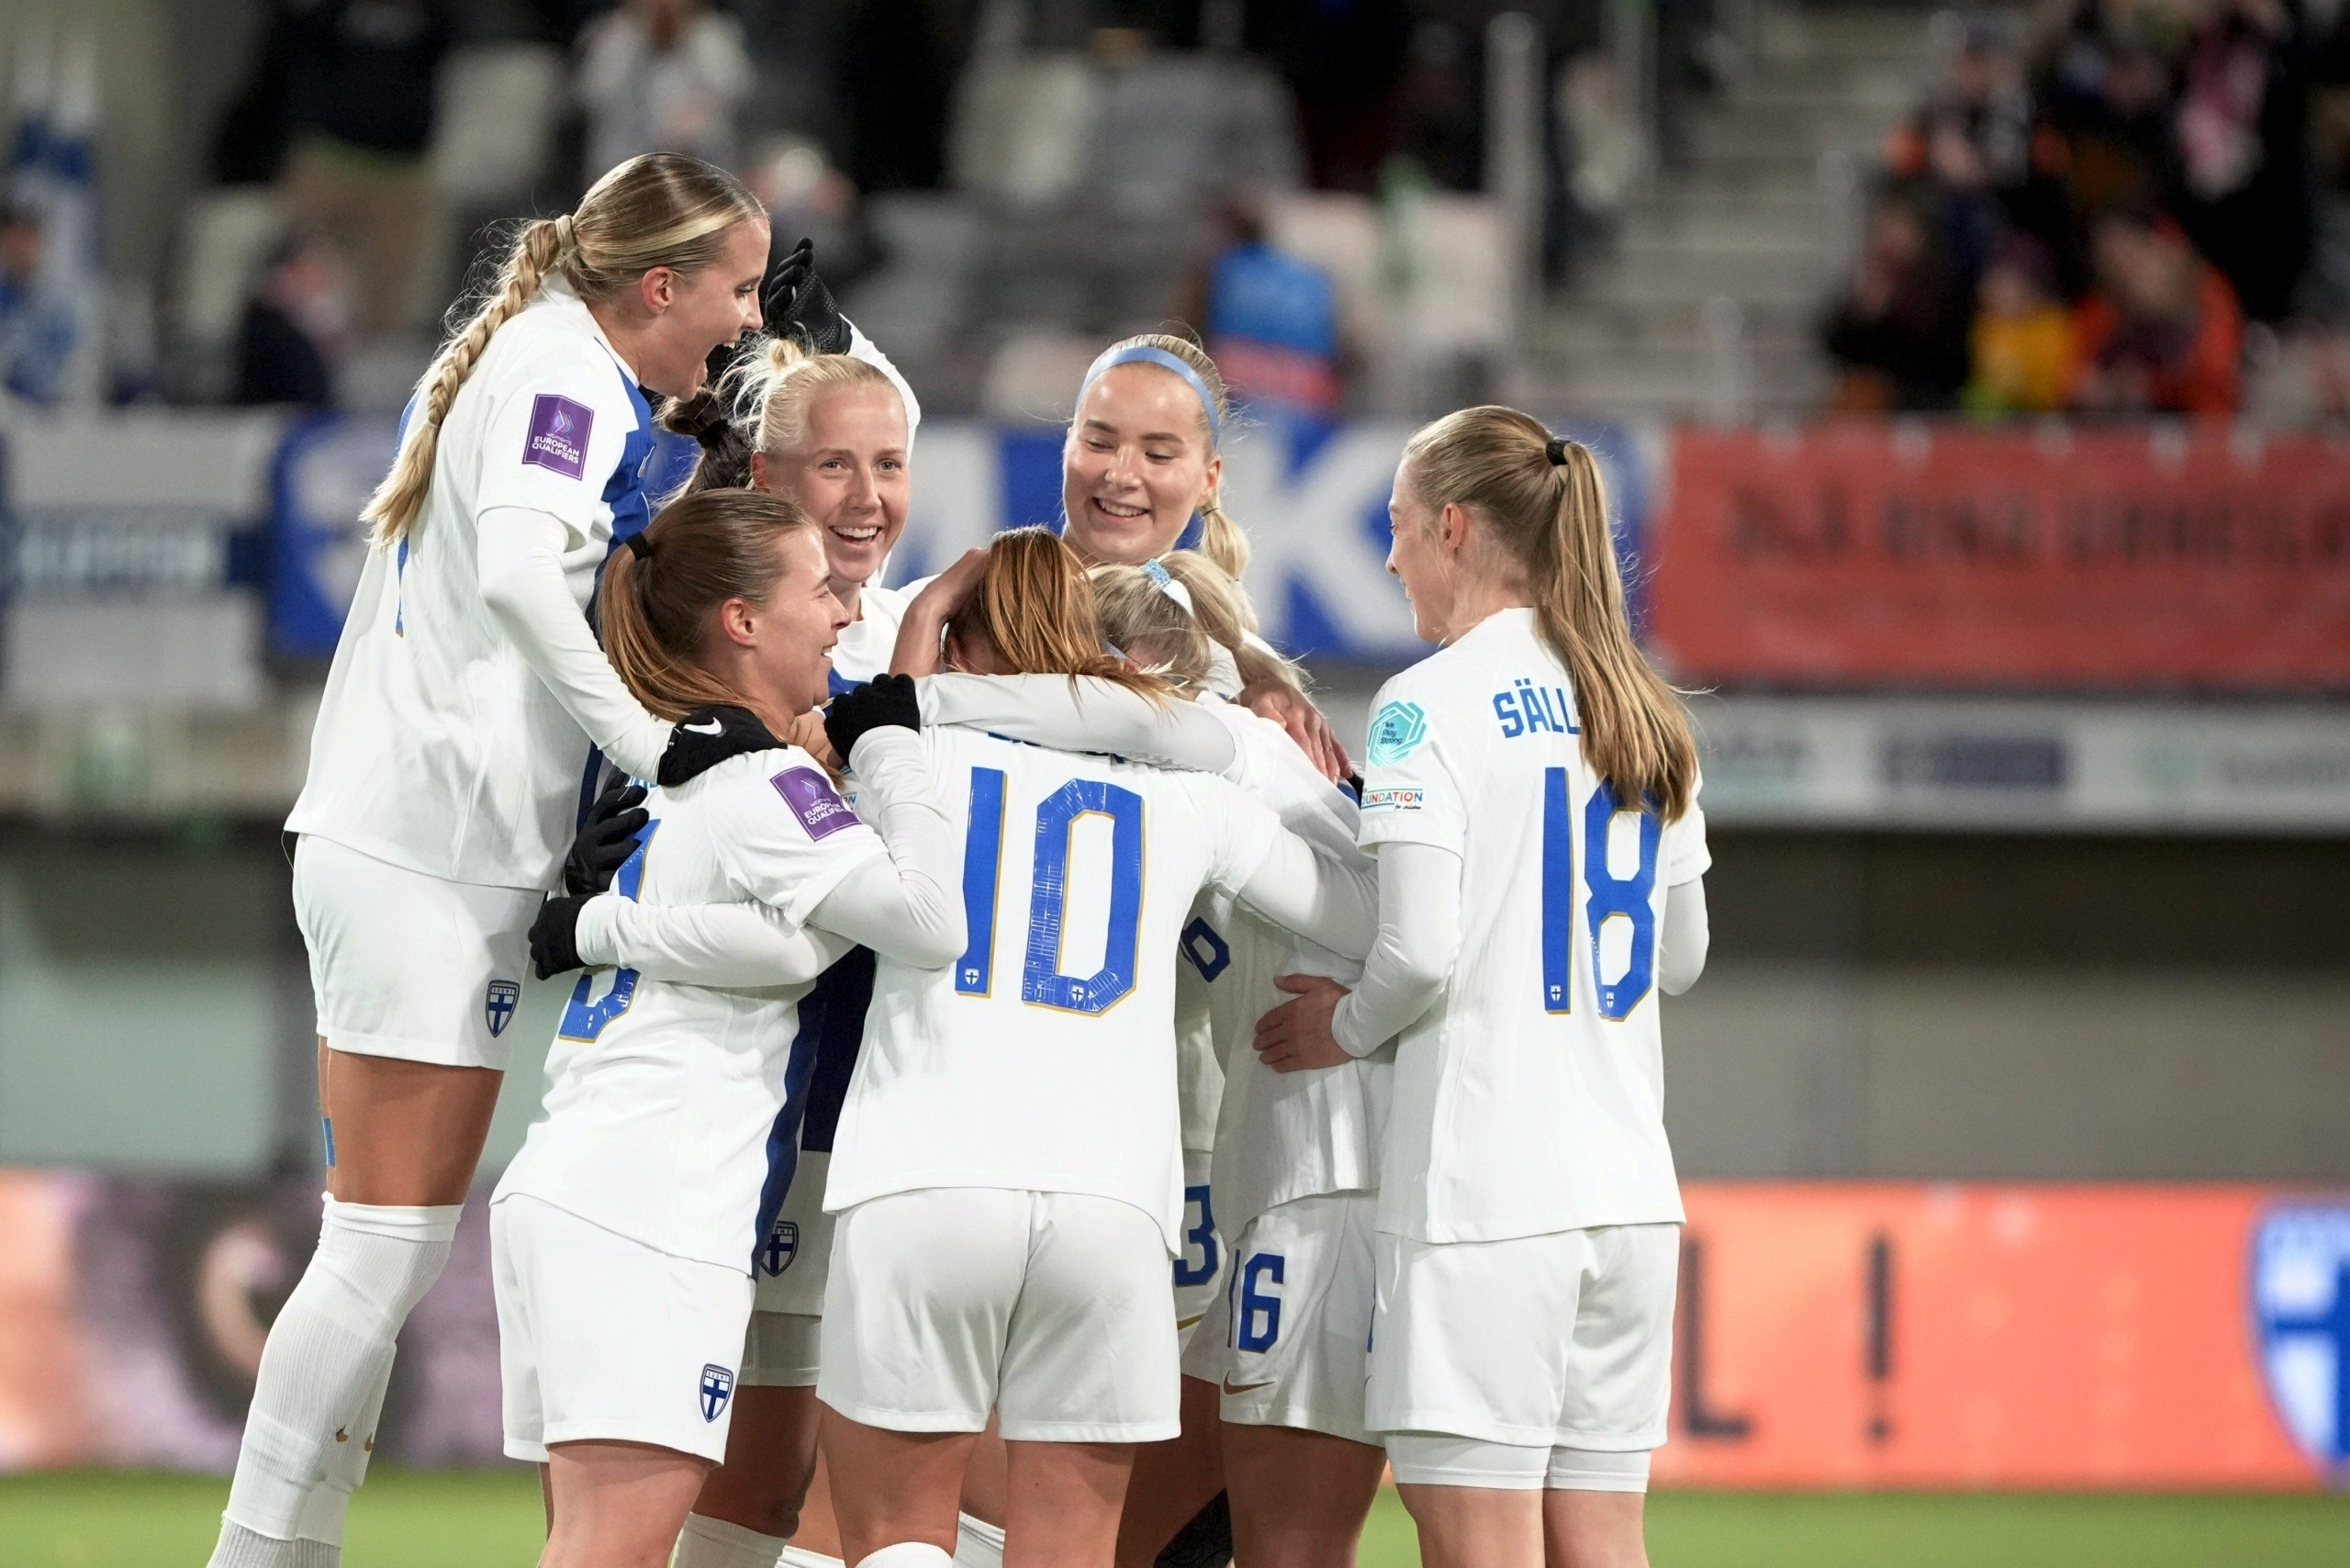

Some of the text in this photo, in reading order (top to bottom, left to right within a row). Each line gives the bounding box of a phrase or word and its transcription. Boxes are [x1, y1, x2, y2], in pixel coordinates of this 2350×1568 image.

[532, 442, 579, 465] QUALIFIERS
[534, 436, 580, 457] EUROPEAN
[1493, 678, 1581, 738] SÄLL
[1380, 736, 1403, 745] Strong
[955, 766, 1146, 1018] 10
[1543, 767, 1664, 1022] 18
